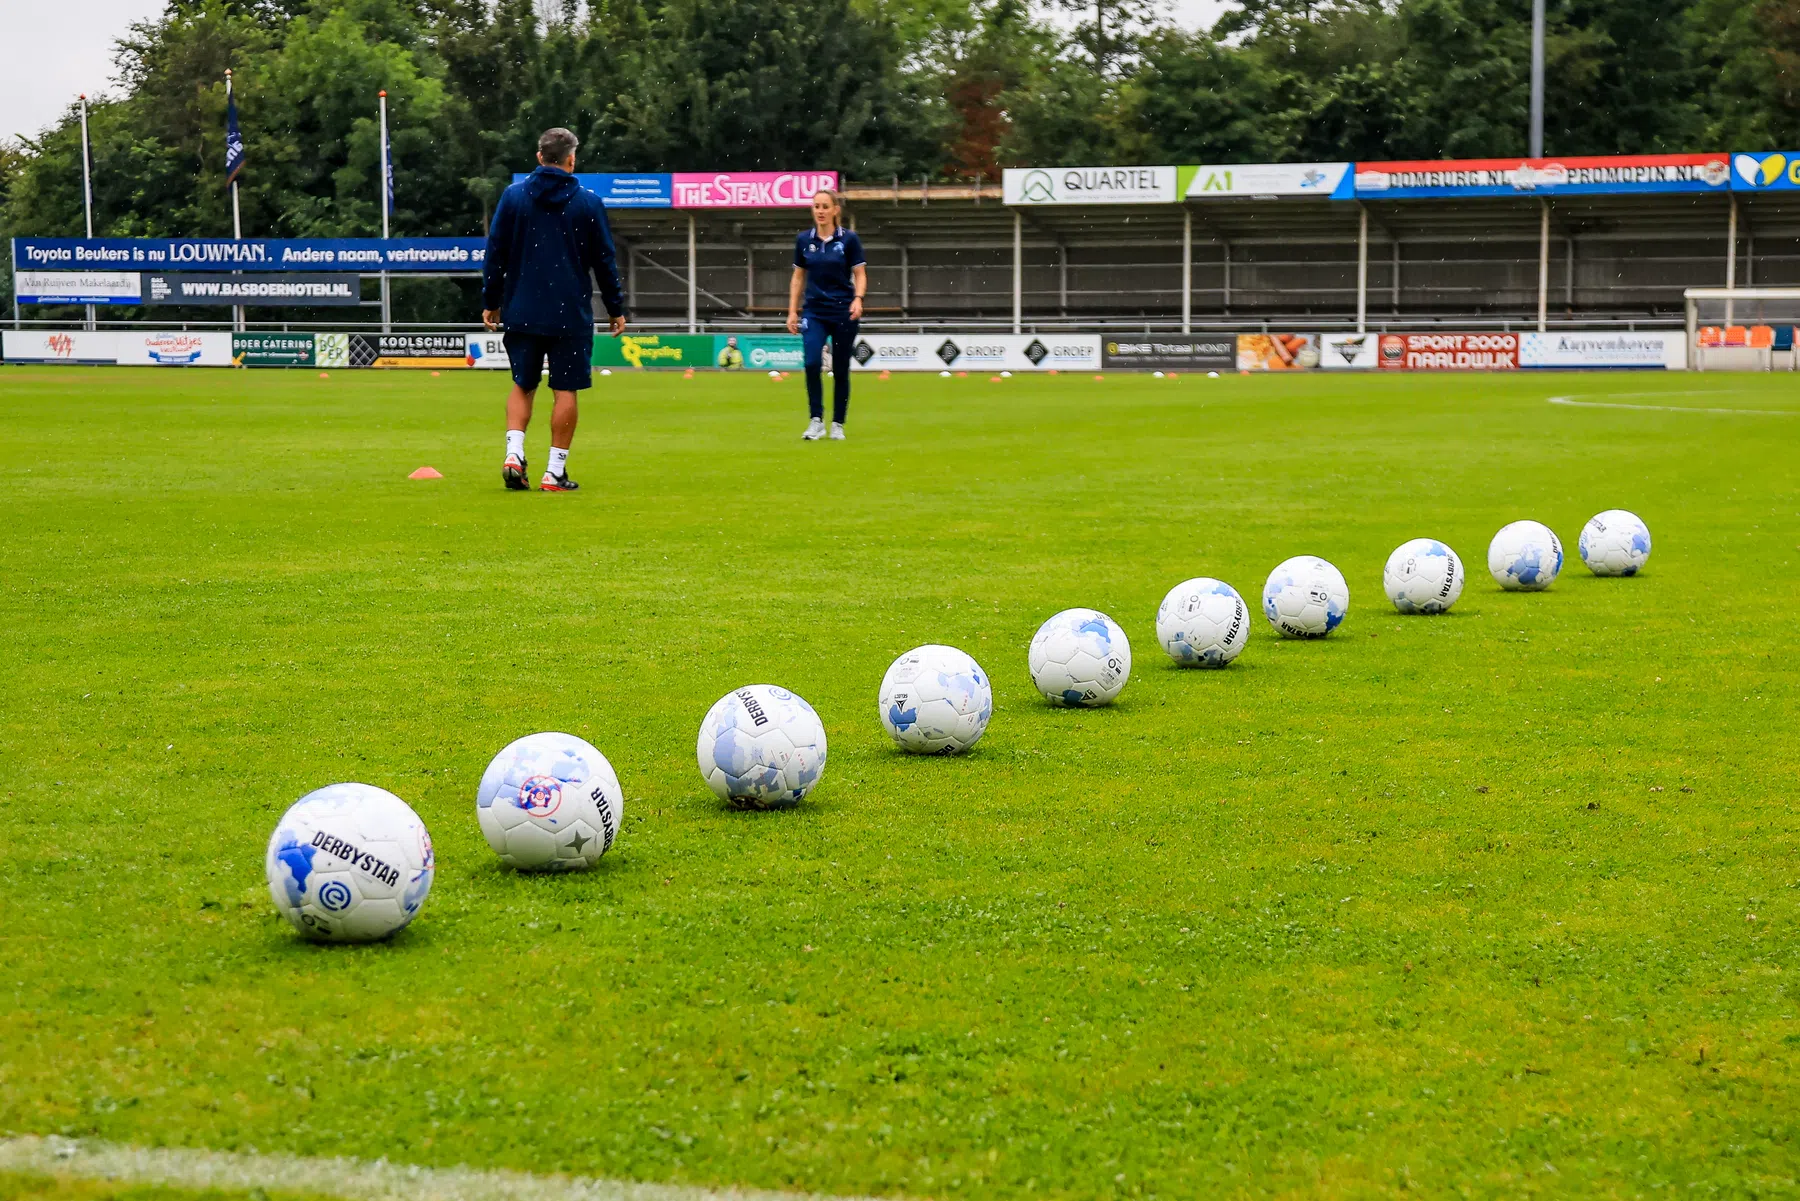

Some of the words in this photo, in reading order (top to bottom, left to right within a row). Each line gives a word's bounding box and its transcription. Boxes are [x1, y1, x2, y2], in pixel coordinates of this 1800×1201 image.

[1064, 170, 1160, 191] QUARTEL
[674, 182, 713, 205] THE
[713, 174, 772, 205] STEAK
[772, 174, 837, 205] CLUB
[25, 245, 71, 264] Toyota
[75, 246, 130, 262] Beukers
[133, 246, 145, 262] is
[148, 251, 166, 262] nu
[282, 247, 335, 263] Andere
[338, 249, 384, 264] naam,
[386, 246, 469, 263] vertrouwde
[24, 277, 42, 288] Van
[44, 277, 77, 290] Ruijven
[79, 277, 131, 290] Makelaardij
[181, 282, 352, 297] WWW.BASBOERNOTEN.NL
[233, 339, 261, 349] BOER
[262, 339, 313, 350] CATERING
[379, 336, 465, 349] KOOLSCHIJN
[1118, 343, 1152, 354] BIKE
[1152, 343, 1193, 354] Totaal
[1407, 335, 1465, 350] SPORT
[1465, 335, 1517, 350] 2000
[879, 346, 919, 357] GROEP
[965, 345, 1006, 356] GROEP
[1053, 346, 1094, 356] GROEP
[1406, 352, 1516, 368] NAALDWIJK
[311, 829, 401, 888] DERBYSTAR
